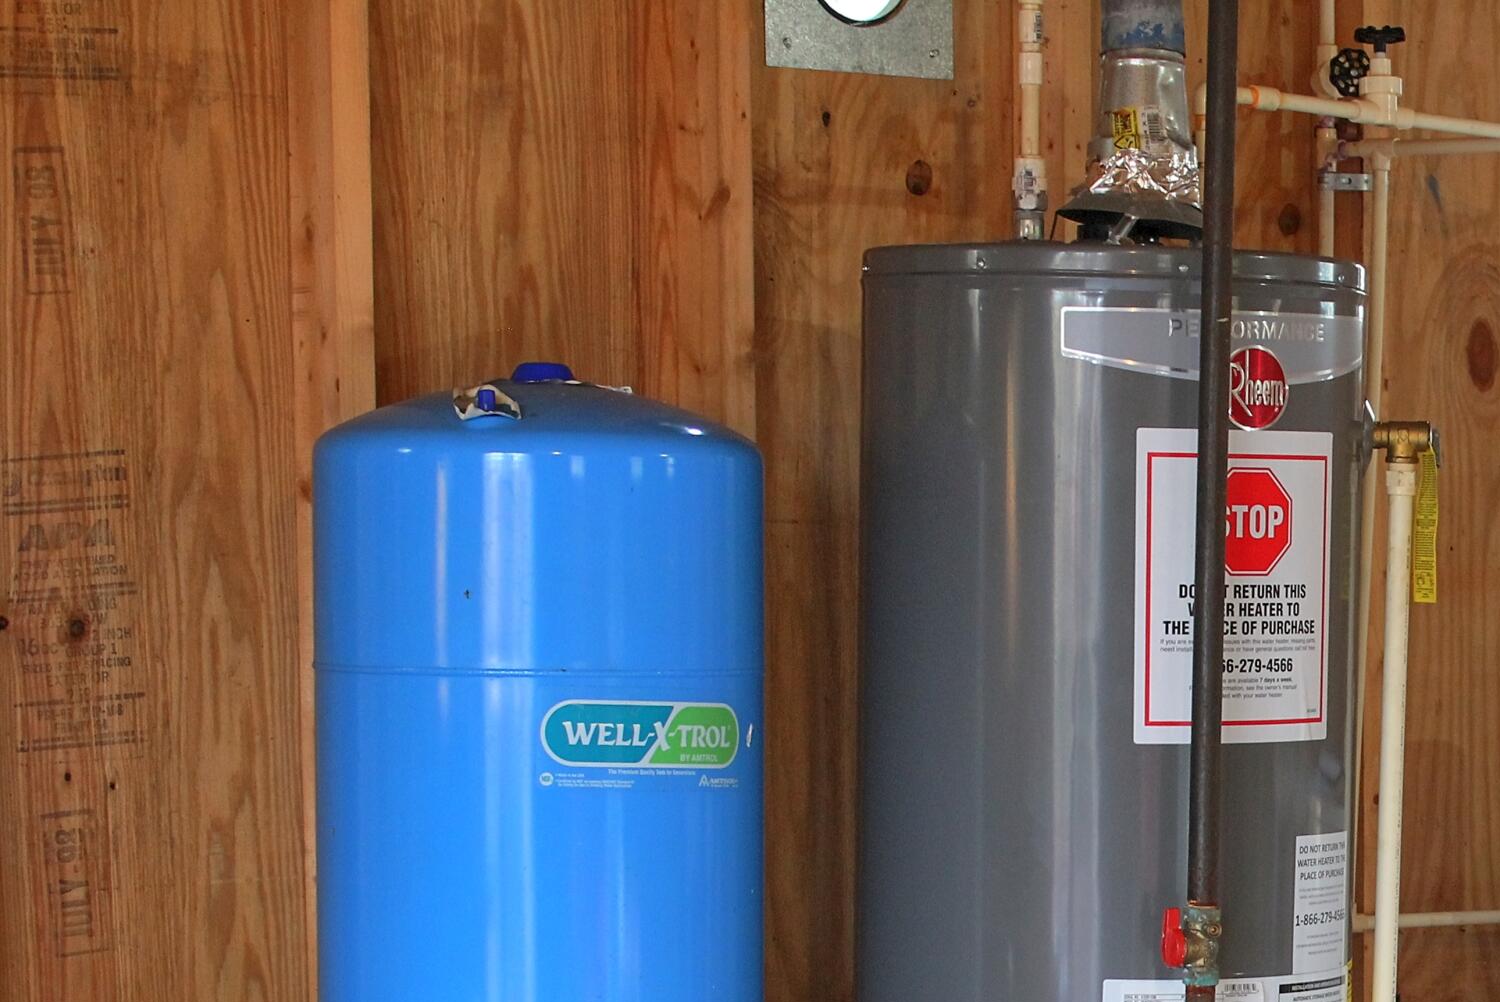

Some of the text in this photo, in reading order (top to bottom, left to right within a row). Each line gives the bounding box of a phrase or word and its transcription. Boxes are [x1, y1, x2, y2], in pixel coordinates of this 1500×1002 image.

[1168, 318, 1326, 343] PEORMANCE
[1230, 350, 1285, 417] Rheem
[1233, 584, 1281, 599] RETURN
[1283, 584, 1306, 598] THIS
[1239, 602, 1284, 617] HEATER
[1286, 602, 1300, 617] TO
[1163, 620, 1189, 635] THE
[1241, 620, 1258, 636] OF
[1261, 619, 1316, 635] PURCHASE
[1222, 658, 1294, 674] 66-279-4566
[562, 720, 731, 752] WELL-X-TROL
[680, 753, 719, 763] BY AMTROL
[1299, 845, 1309, 855] DO
[1309, 844, 1321, 854] NOT
[1297, 858, 1317, 868] WATER
[1317, 856, 1335, 866] HEATER
[1300, 871, 1318, 881] PLACE
[1318, 870, 1326, 879] OF
